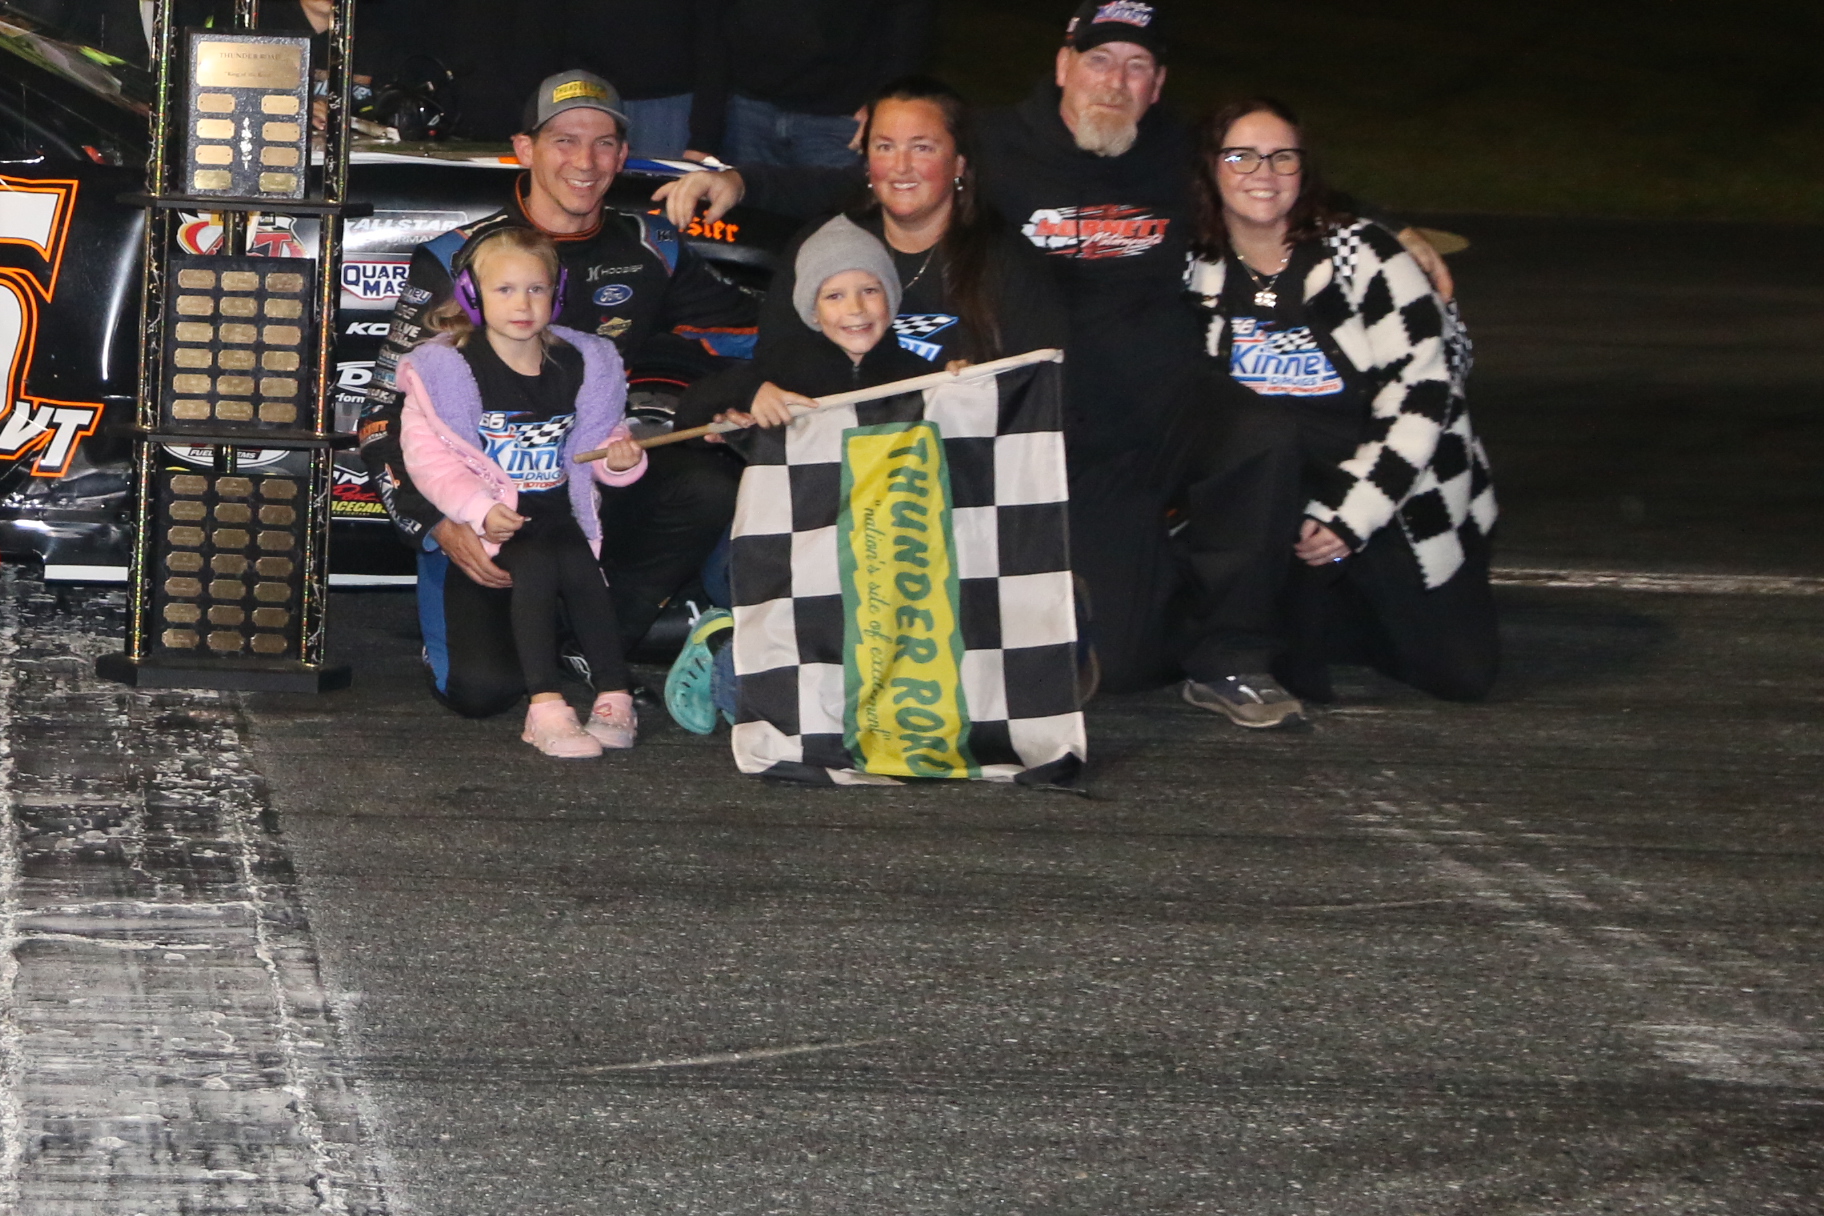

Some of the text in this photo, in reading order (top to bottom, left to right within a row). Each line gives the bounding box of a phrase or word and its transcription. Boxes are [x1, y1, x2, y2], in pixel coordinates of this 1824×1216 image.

[354, 219, 461, 231] ALLSTAR
[343, 265, 410, 286] QUAR
[479, 413, 506, 429] 66
[487, 440, 556, 472] Kinn
[524, 471, 561, 481] DRUG
[888, 437, 939, 665] THUNDER
[866, 578, 890, 616] site
[867, 620, 891, 641] of
